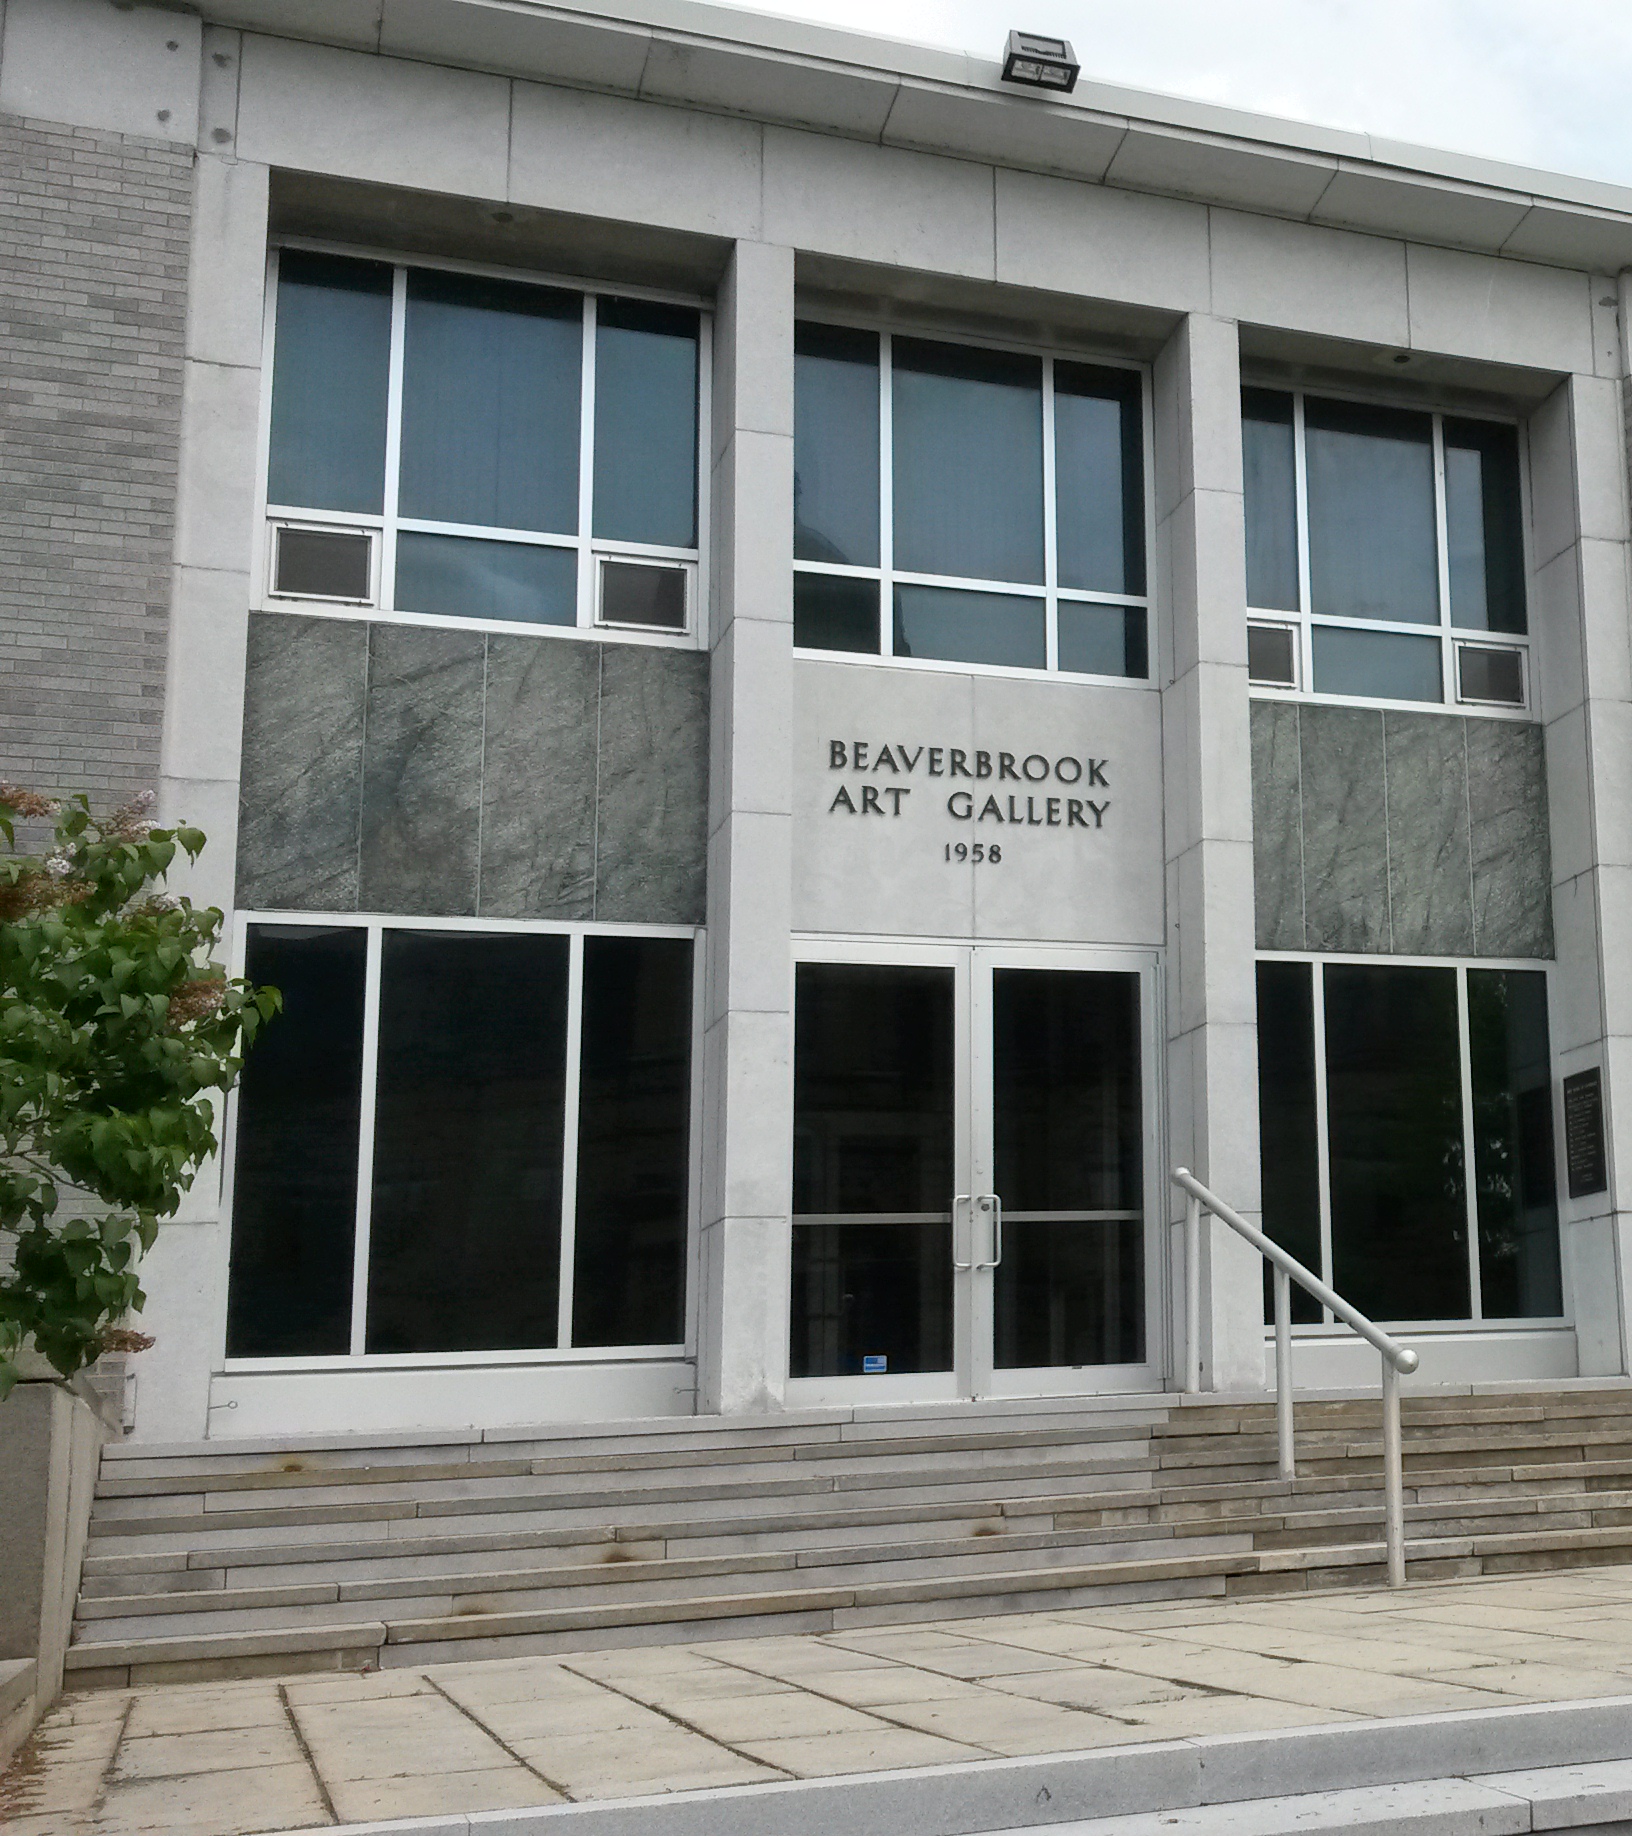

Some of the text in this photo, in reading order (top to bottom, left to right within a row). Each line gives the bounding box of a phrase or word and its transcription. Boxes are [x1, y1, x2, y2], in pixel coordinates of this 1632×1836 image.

[829, 739, 1111, 788] BEAVERBROOK
[828, 785, 1111, 829] ART GALLERY
[944, 842, 1003, 864] 1958
